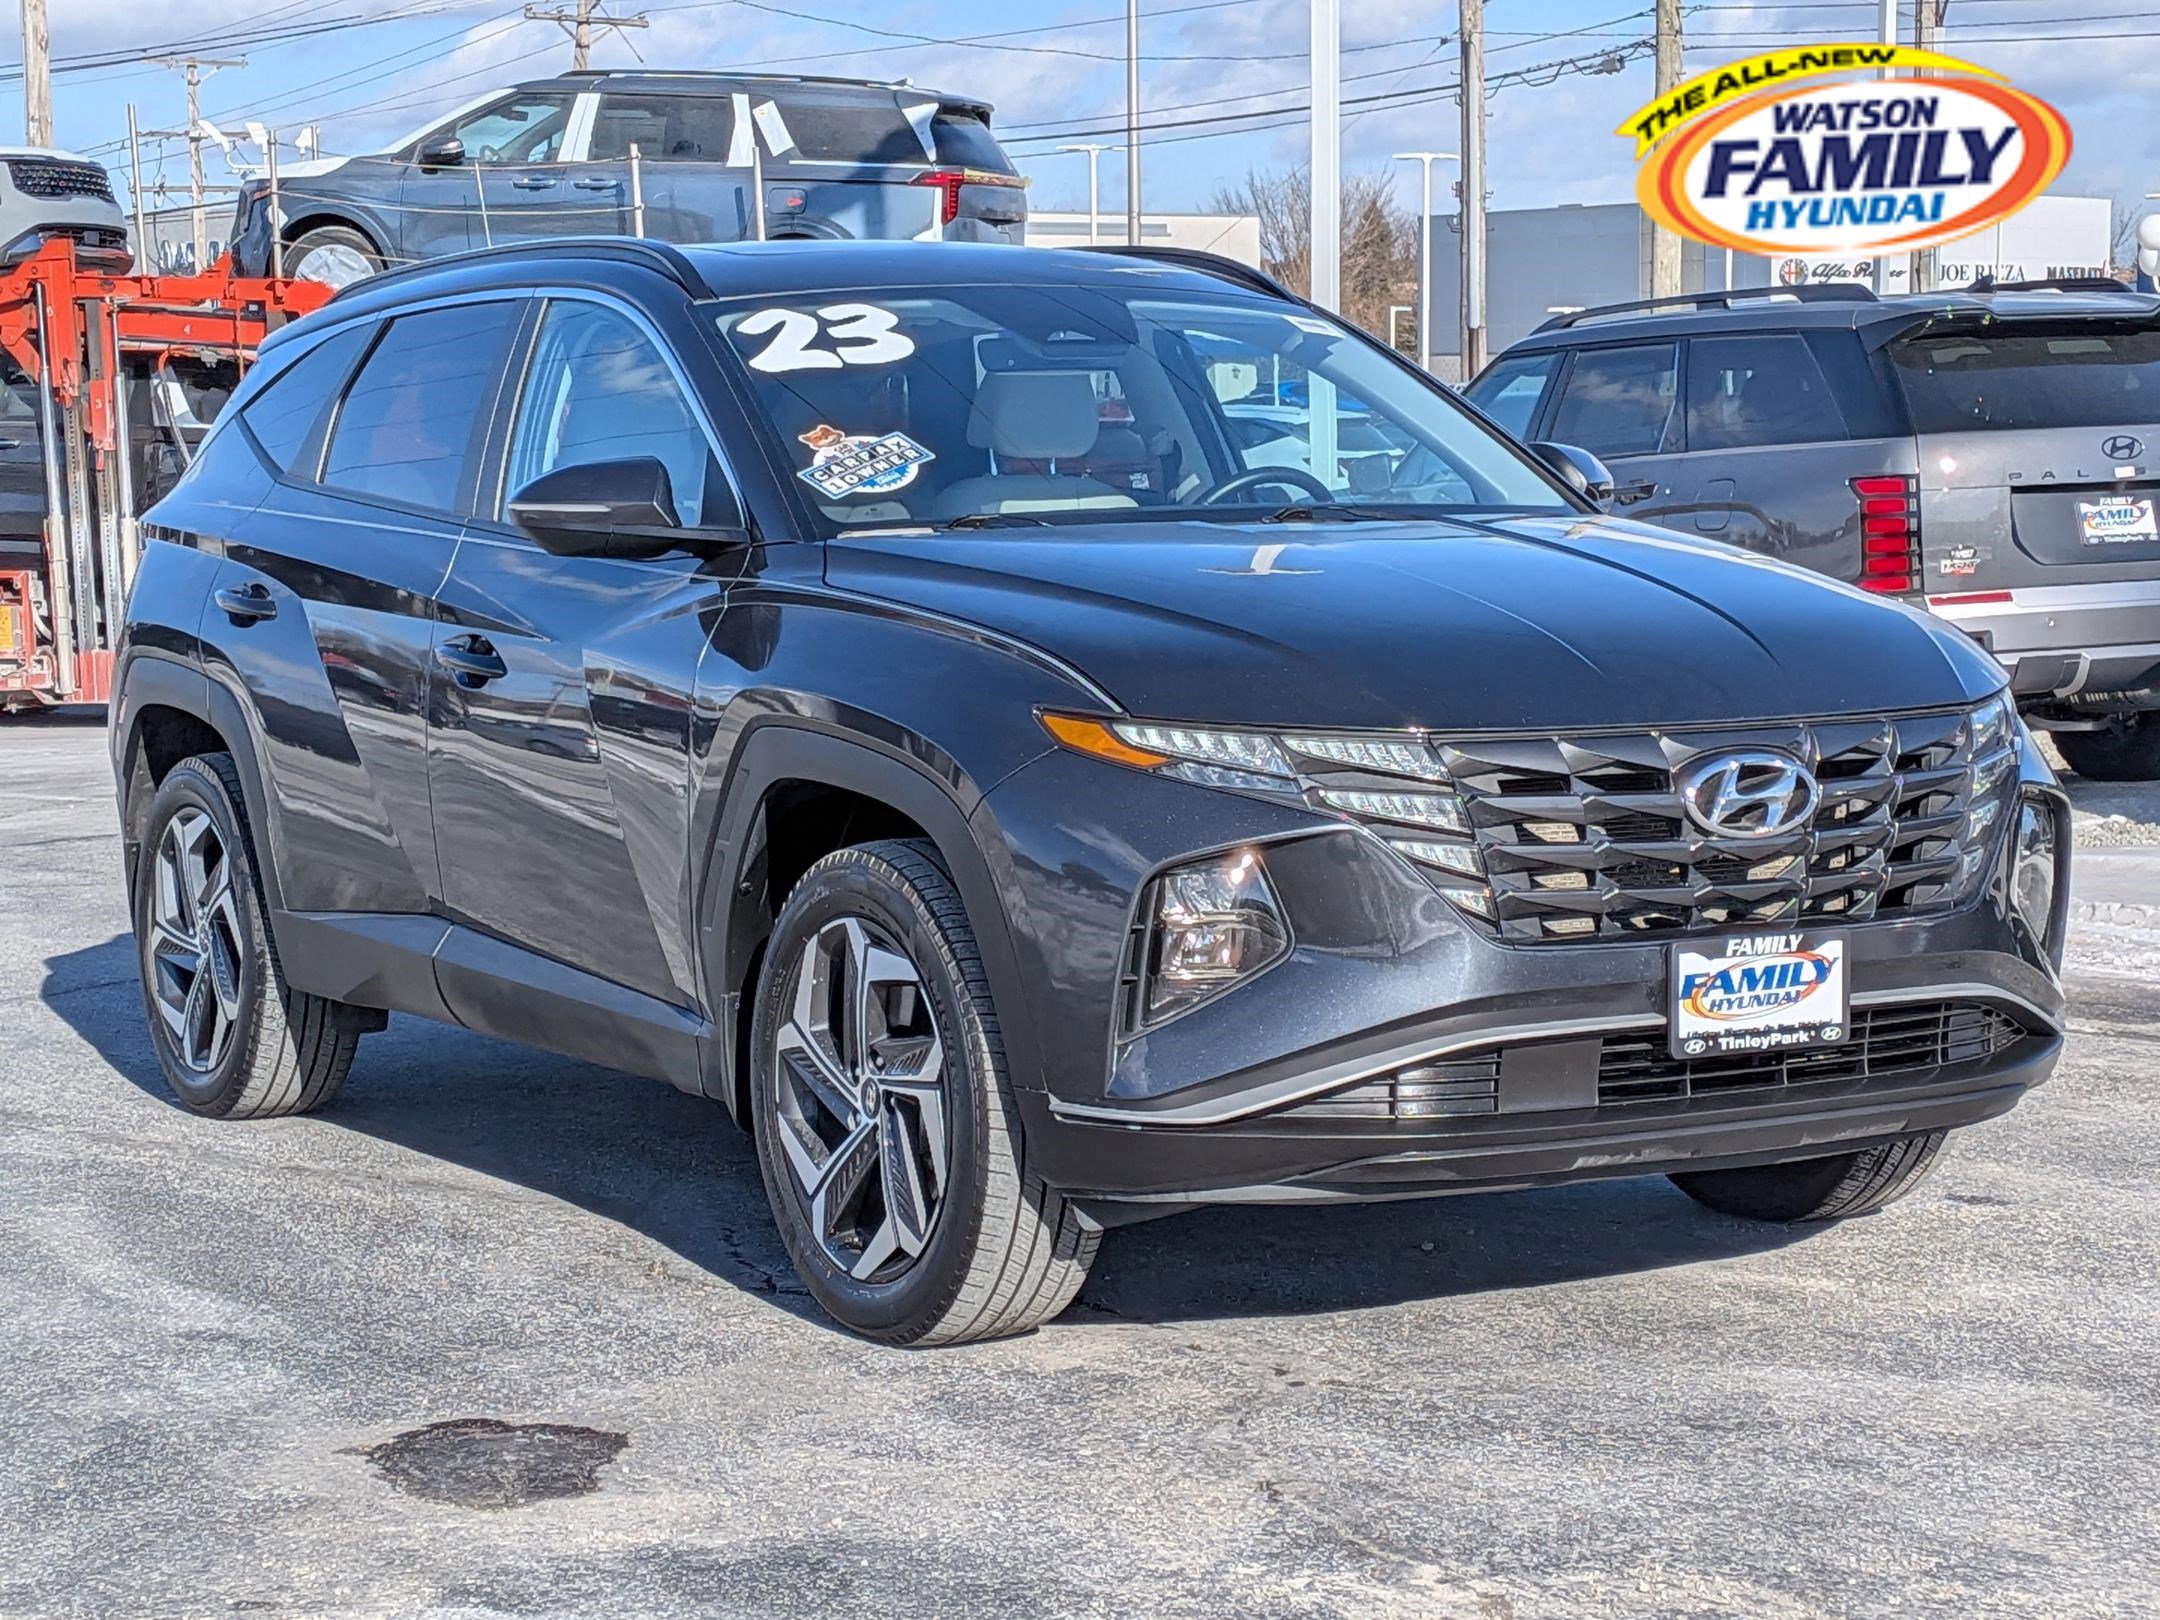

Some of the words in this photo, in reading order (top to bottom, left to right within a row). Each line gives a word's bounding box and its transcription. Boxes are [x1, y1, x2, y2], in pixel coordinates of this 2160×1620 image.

[1811, 262, 1852, 286] Alfa
[1853, 260, 1908, 279] Roeo
[1938, 264, 1970, 282] JOE
[183, 324, 191, 335] 4
[735, 303, 916, 373] 23
[1726, 934, 1804, 957] FAMILY
[1679, 956, 1840, 1000] FAMILY
[1708, 990, 1803, 1013] HYUNDAI
